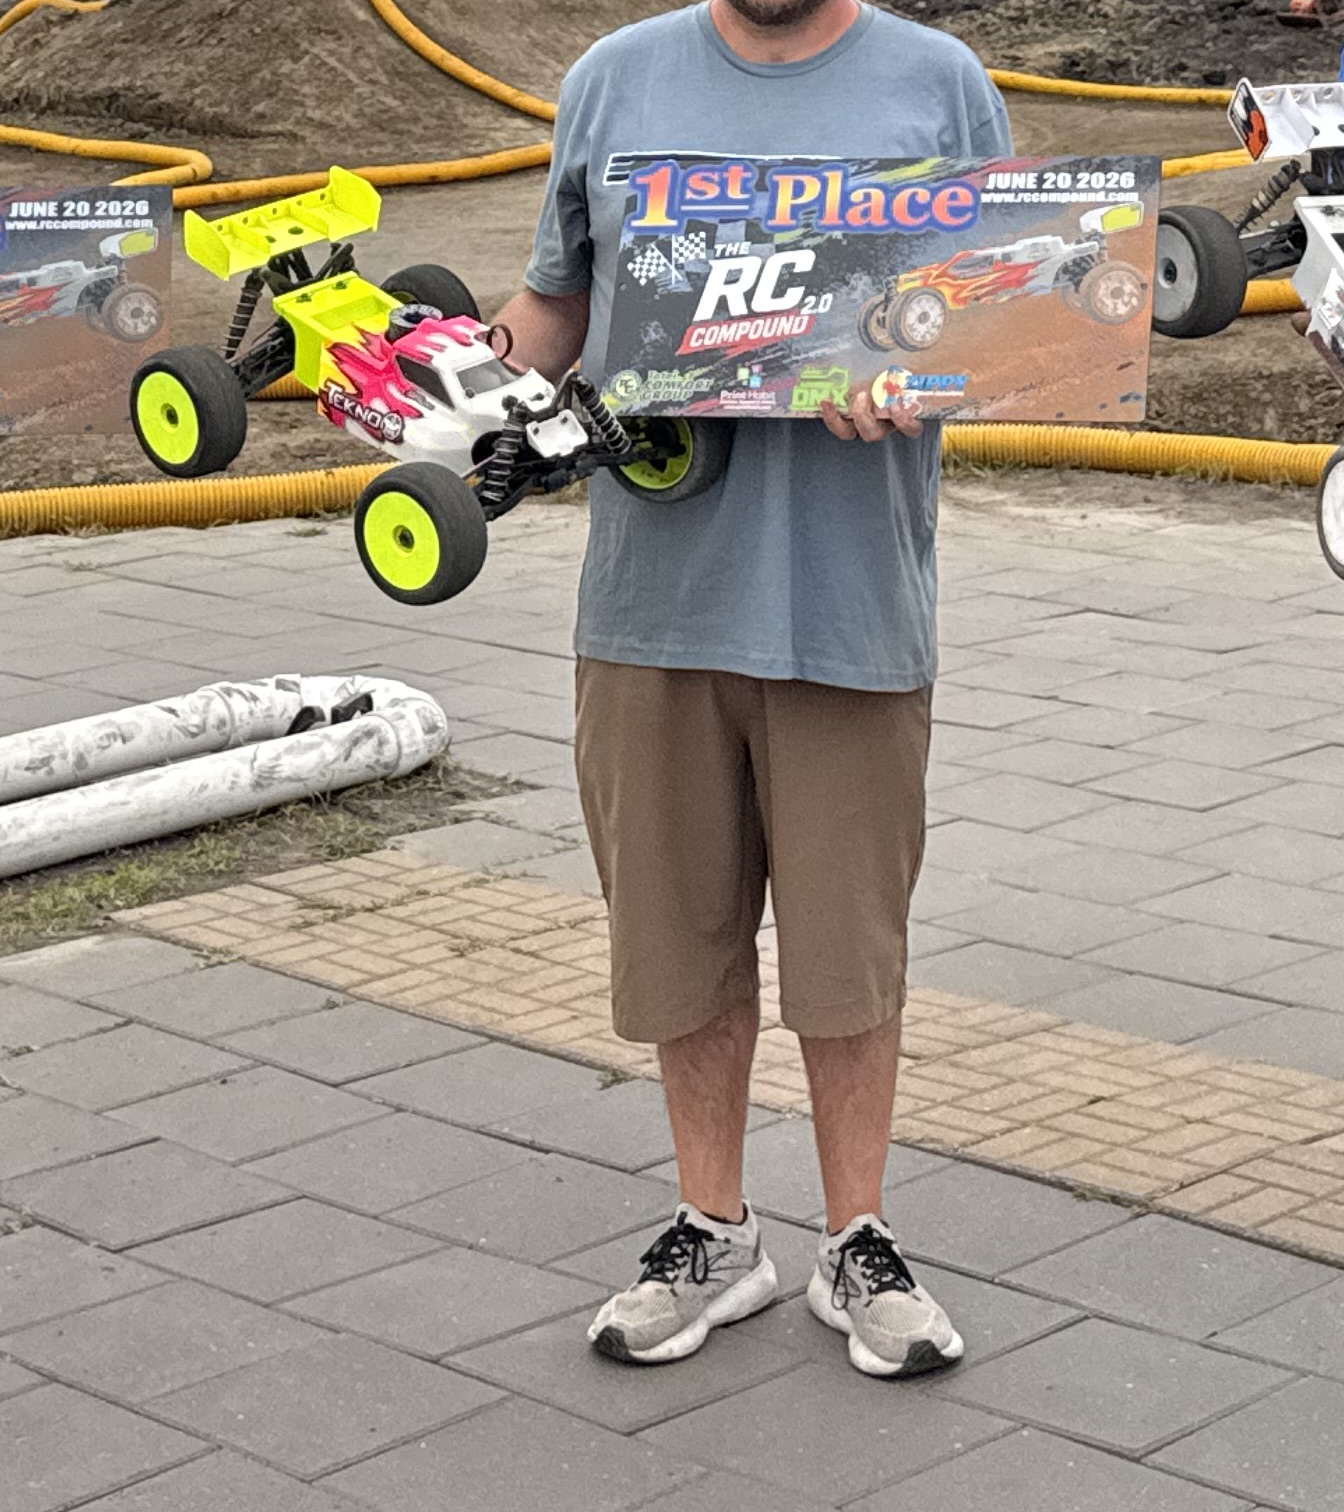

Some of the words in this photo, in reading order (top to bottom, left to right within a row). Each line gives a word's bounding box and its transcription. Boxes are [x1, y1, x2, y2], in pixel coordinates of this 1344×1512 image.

[986, 172, 1039, 190] JUNE
[1042, 172, 1072, 189] 20
[1076, 171, 1136, 189] 2026
[630, 165, 752, 227] 1st
[767, 170, 975, 227] Place
[980, 190, 1139, 203] www.rccompound.com
[9, 201, 59, 217] JUNE
[63, 200, 91, 217] 20
[94, 200, 150, 217] 2026
[5, 217, 154, 231] www.rccompound.com
[713, 241, 752, 257] THE
[692, 249, 816, 322] RC
[800, 293, 833, 315] 2.0
[689, 315, 810, 348] COMPOUND
[644, 379, 714, 391] COMFORT
[643, 390, 693, 401] GROUP
[720, 390, 746, 400] Print
[748, 390, 776, 399] Habit
[325, 380, 383, 428] TEKNO
